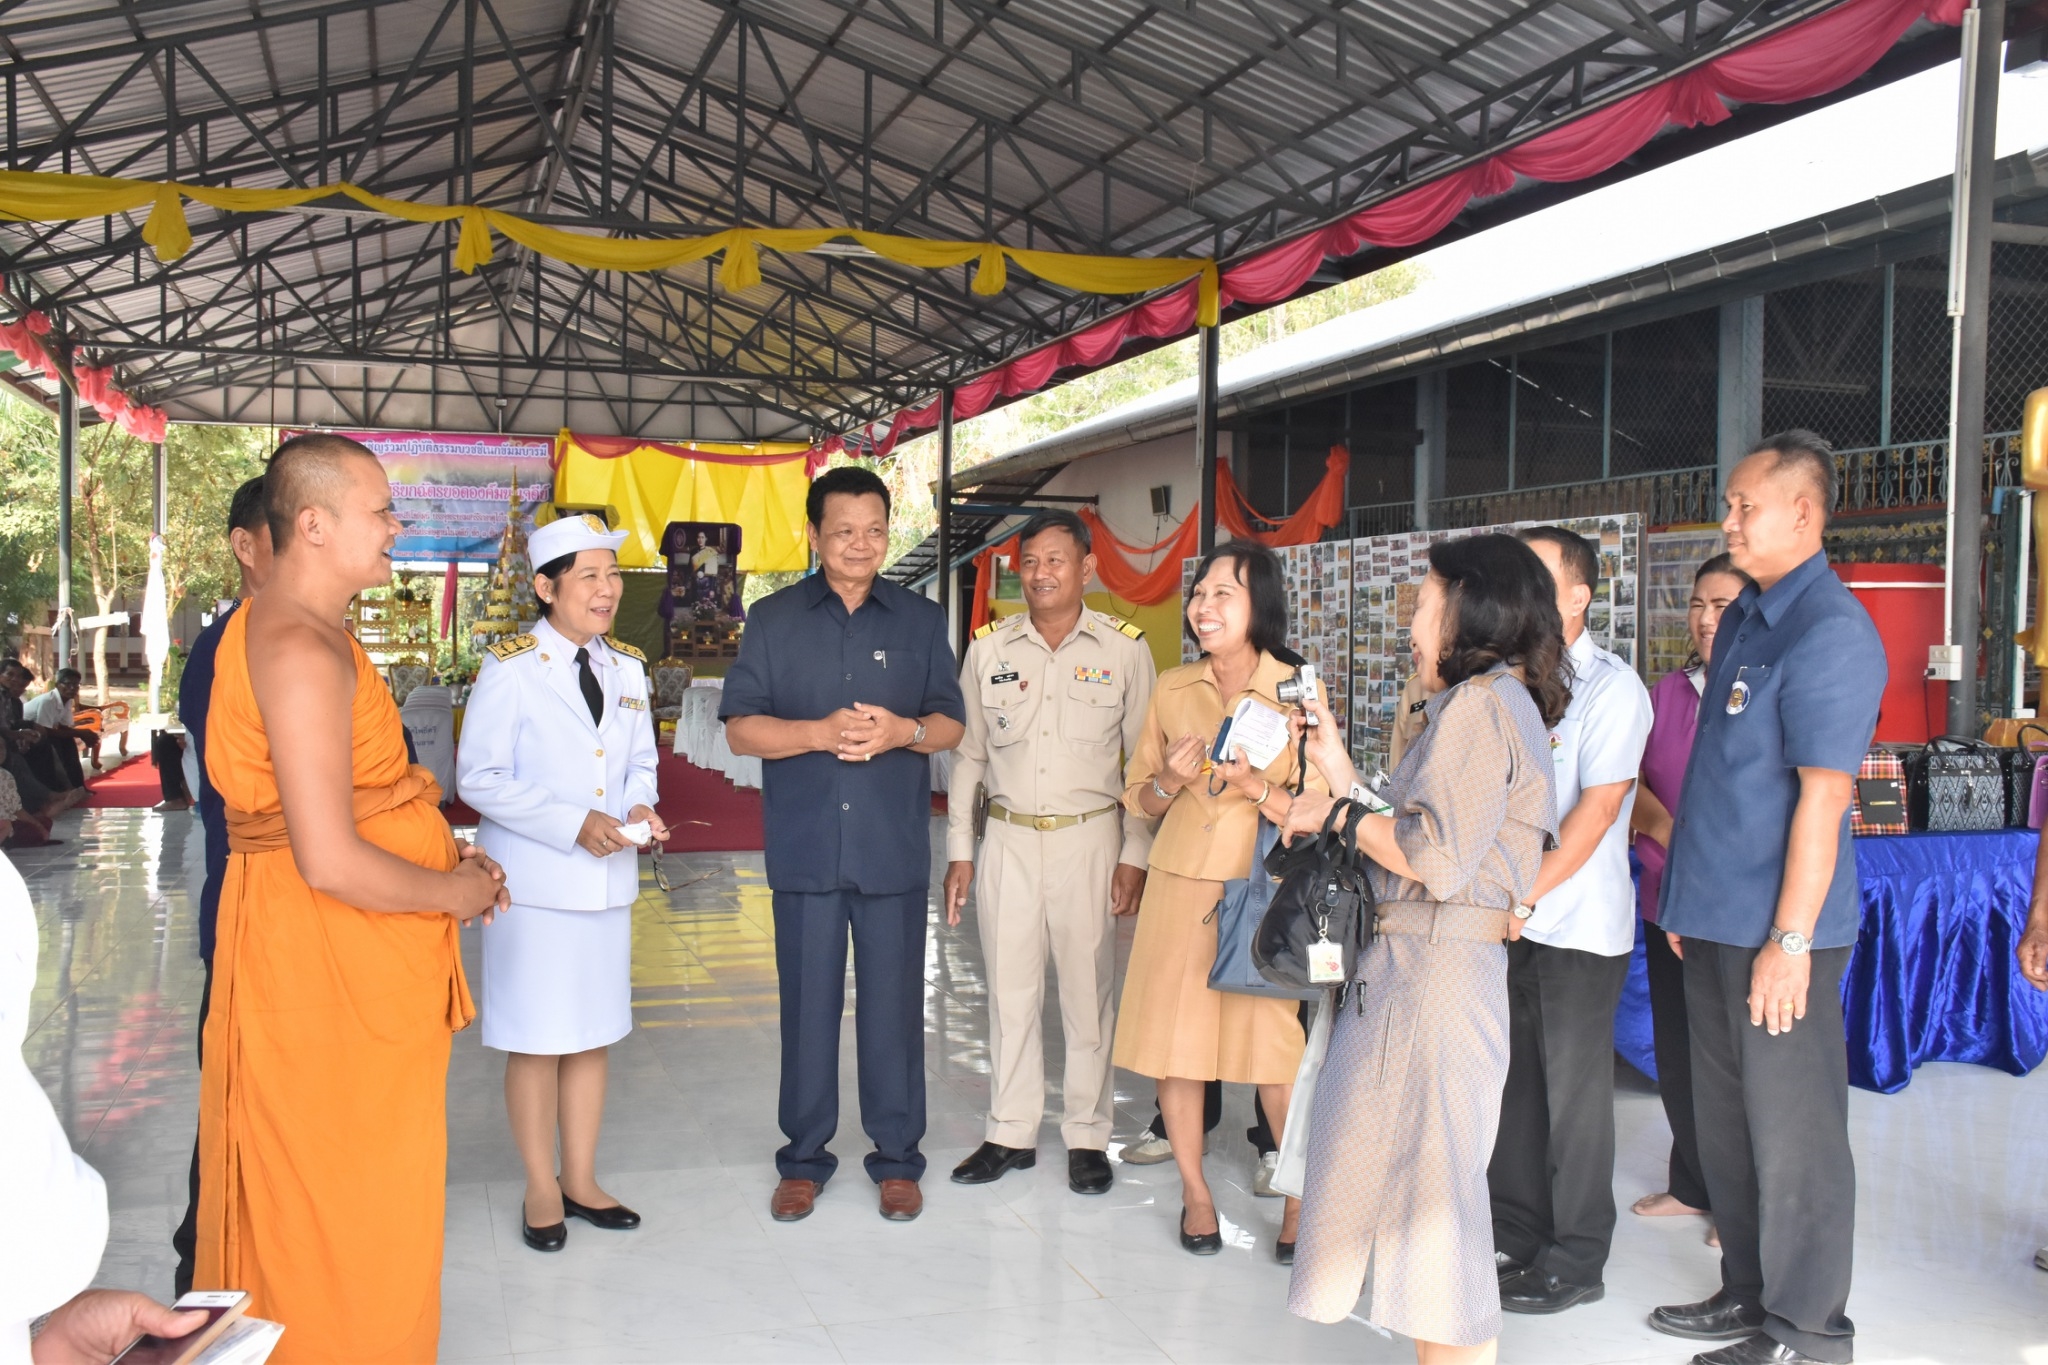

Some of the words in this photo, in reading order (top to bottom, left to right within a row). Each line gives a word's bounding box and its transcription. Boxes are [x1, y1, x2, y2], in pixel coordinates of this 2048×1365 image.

[365, 439, 547, 457] ชิญร่วมปฏิบัติธรรมบวชชีเนกขัมมบารมี
[388, 482, 551, 501] ธียกฉัตรยอดองค์มหเจดีย์
